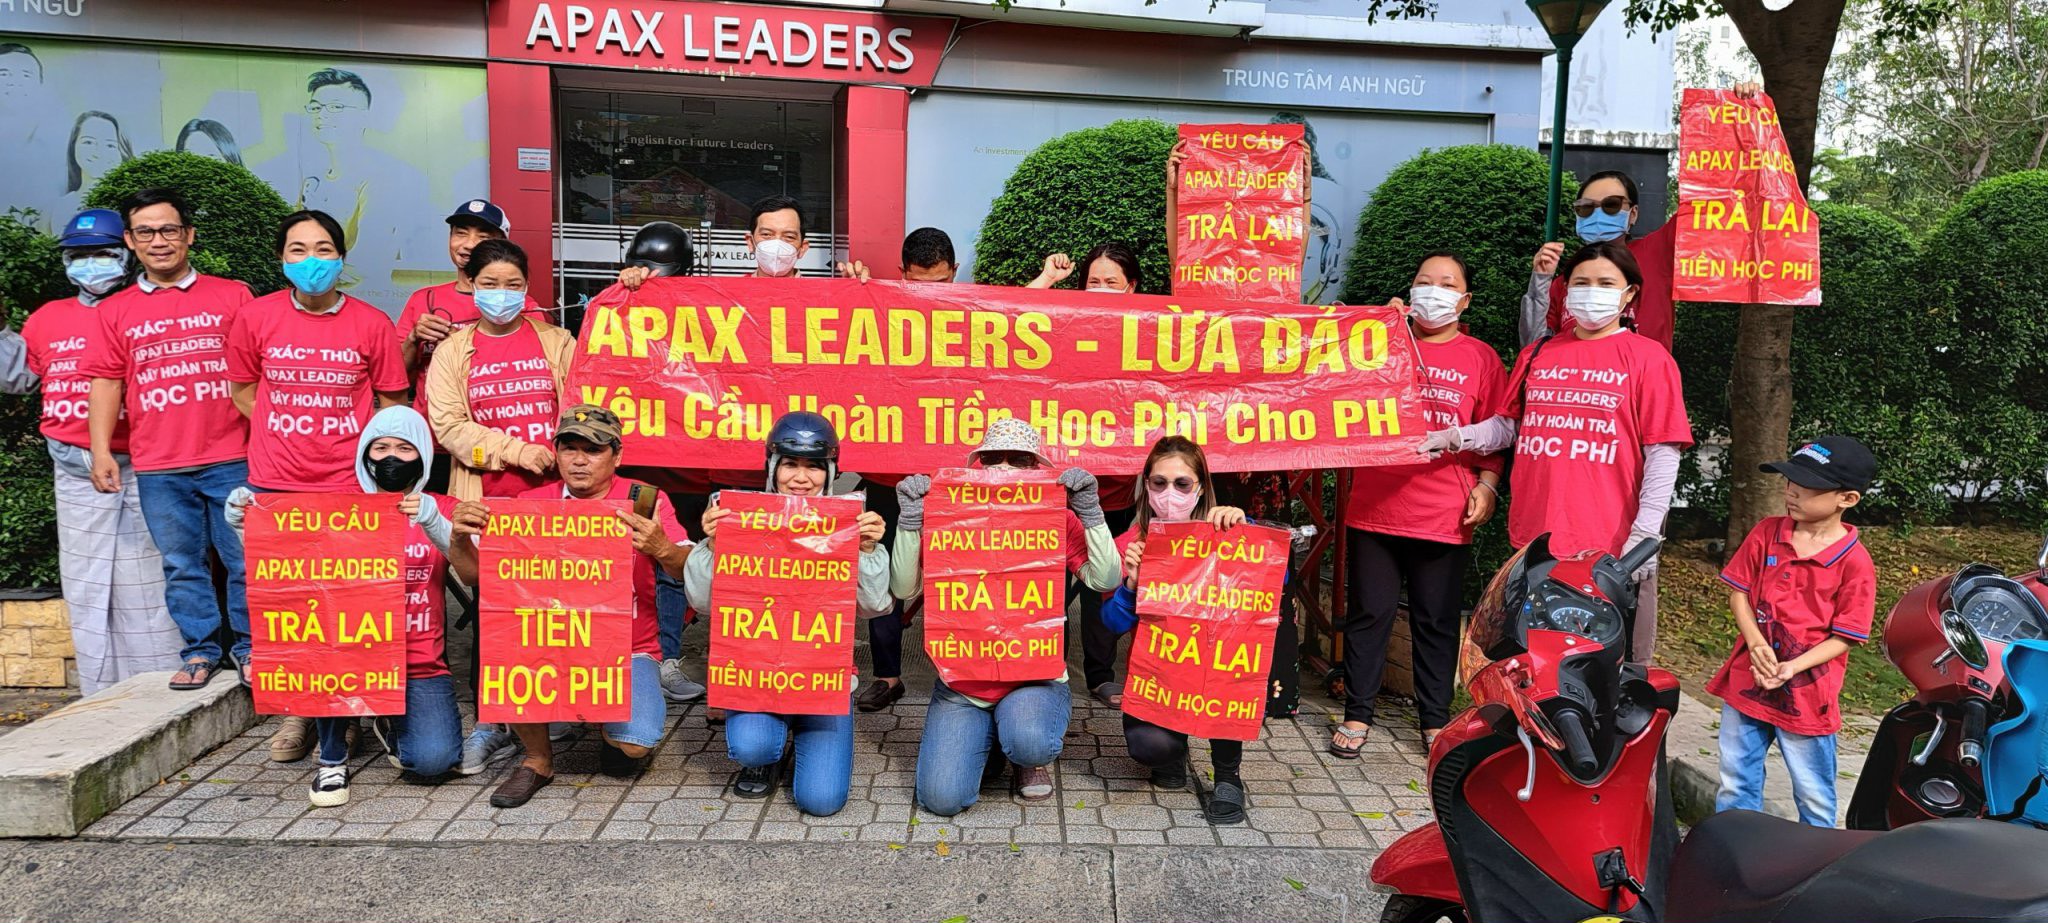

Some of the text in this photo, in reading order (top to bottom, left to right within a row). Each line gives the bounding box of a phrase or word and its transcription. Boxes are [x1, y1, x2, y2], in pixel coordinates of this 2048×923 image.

[526, 3, 914, 71] APAX LEADERS
[1222, 68, 1426, 96] TRUNG TÂM ANH NGỮ
[668, 136, 687, 146] For
[690, 137, 726, 148] Future
[730, 139, 774, 150] Leaders
[1200, 130, 1285, 150] YÊU CẦU
[1686, 151, 1734, 171] APAX
[1185, 170, 1298, 190] APAX LEADERS
[1187, 202, 1293, 246] TRẢ LẠI
[1691, 190, 1809, 238] TRẢ LẠI
[702, 252, 728, 260] APAX
[730, 252, 756, 260] LEAD
[1680, 252, 1813, 282] TIỀN HỌC PHÍ
[1180, 259, 1296, 284] TIỀN HỌC PHÍ
[164, 338, 222, 354] LEADERS
[587, 306, 748, 364] APAX
[771, 307, 1053, 370] LEADERS
[1122, 304, 1240, 374] LỪA
[1260, 304, 1389, 374] ĐẢO
[49, 360, 78, 372] APAX
[160, 360, 201, 379] HOÀN
[266, 369, 358, 384] APAX LEADERS
[1582, 368, 1628, 386] THỦY
[72, 381, 91, 393] HO
[140, 384, 188, 412] HỌC
[292, 392, 333, 408] HOÀN
[469, 380, 553, 399] APAX LEADERS
[1420, 388, 1460, 404] ADERS
[1527, 390, 1618, 408] APAX LEADERS
[43, 400, 89, 422] HỌC
[267, 410, 360, 438] HỌC PHÍ
[474, 408, 493, 422] HY
[496, 402, 534, 418] HOÀN
[683, 386, 773, 440] Cầu
[1030, 400, 1115, 456] Học
[1133, 399, 1208, 447] Phí
[1226, 402, 1317, 445] Cho
[1333, 397, 1401, 439] PH
[1523, 411, 1544, 428] HÃY
[1546, 413, 1584, 430] HOÀN
[528, 417, 556, 441] PH
[1516, 435, 1620, 465] HỌC PHÍ
[947, 480, 1042, 504] YÊU CẦU
[273, 504, 380, 532] YÊU CẦU
[486, 514, 627, 538] APAX LEADERS
[739, 507, 837, 535] YÊU CẦU
[404, 543, 432, 558] HỦY
[929, 529, 1060, 552] APAX LEADERS
[1170, 535, 1265, 564] YÊU CẦU
[255, 559, 305, 580] APAX
[310, 558, 398, 580] LEADERS
[498, 554, 614, 586] CHIẾM ĐOẠT
[716, 554, 851, 582] APAX LEADERS
[934, 569, 1054, 616] TRẢ LẠI
[1144, 582, 1275, 613] APAX LEADERS
[263, 599, 393, 648] TRẢ LẠI
[406, 607, 432, 632] HÍ
[514, 598, 592, 648] TIỀN
[719, 596, 843, 650] TRẢ LẠI
[929, 632, 1060, 662] TIỀN HỌC PHÍ
[1148, 623, 1262, 679] TRẢ LẠI
[258, 664, 400, 695] TIỀN HỌC PHÍ
[482, 656, 625, 715] HỌC PHÍ
[709, 660, 845, 694] TIỀN HỌC PHÍ
[1132, 674, 1260, 720] TIỀN HỌC PHÍ
